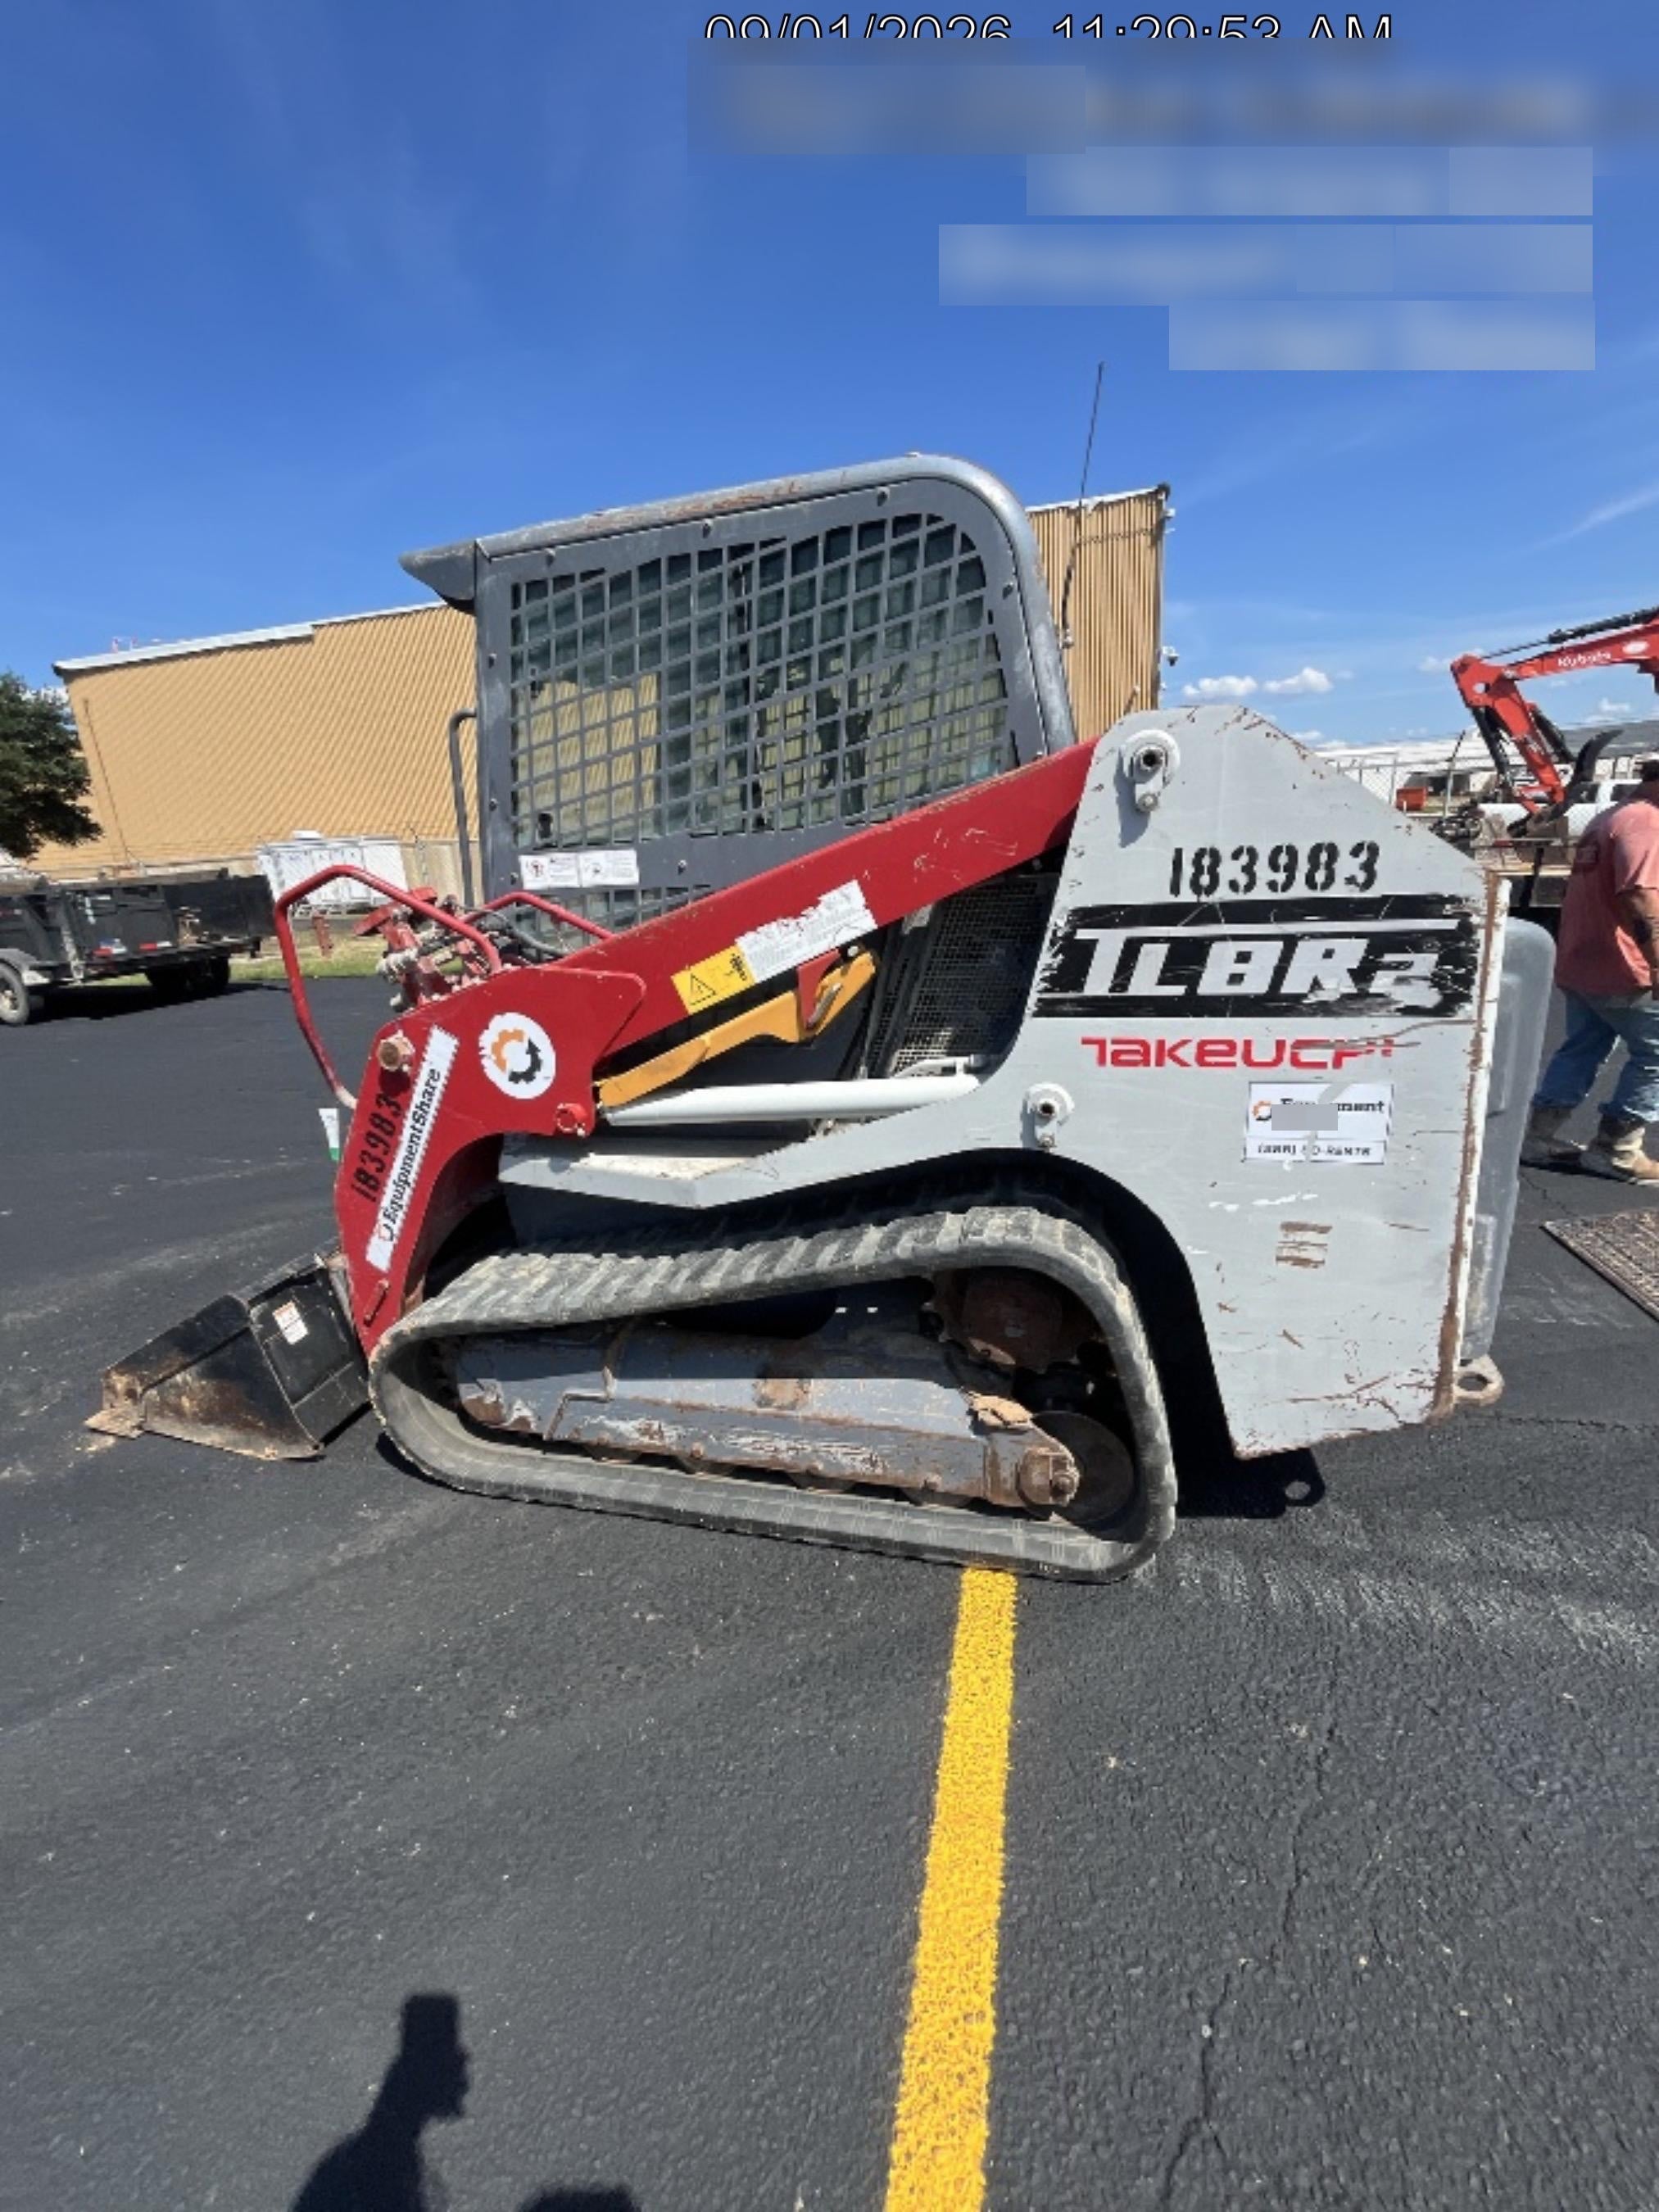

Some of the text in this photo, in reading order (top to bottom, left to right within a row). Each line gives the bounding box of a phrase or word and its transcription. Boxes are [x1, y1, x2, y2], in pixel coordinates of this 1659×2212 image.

[1169, 841, 1380, 898] 183983
[351, 1092, 403, 1202] 183983
[383, 1068, 441, 1226] EquipmentShare
